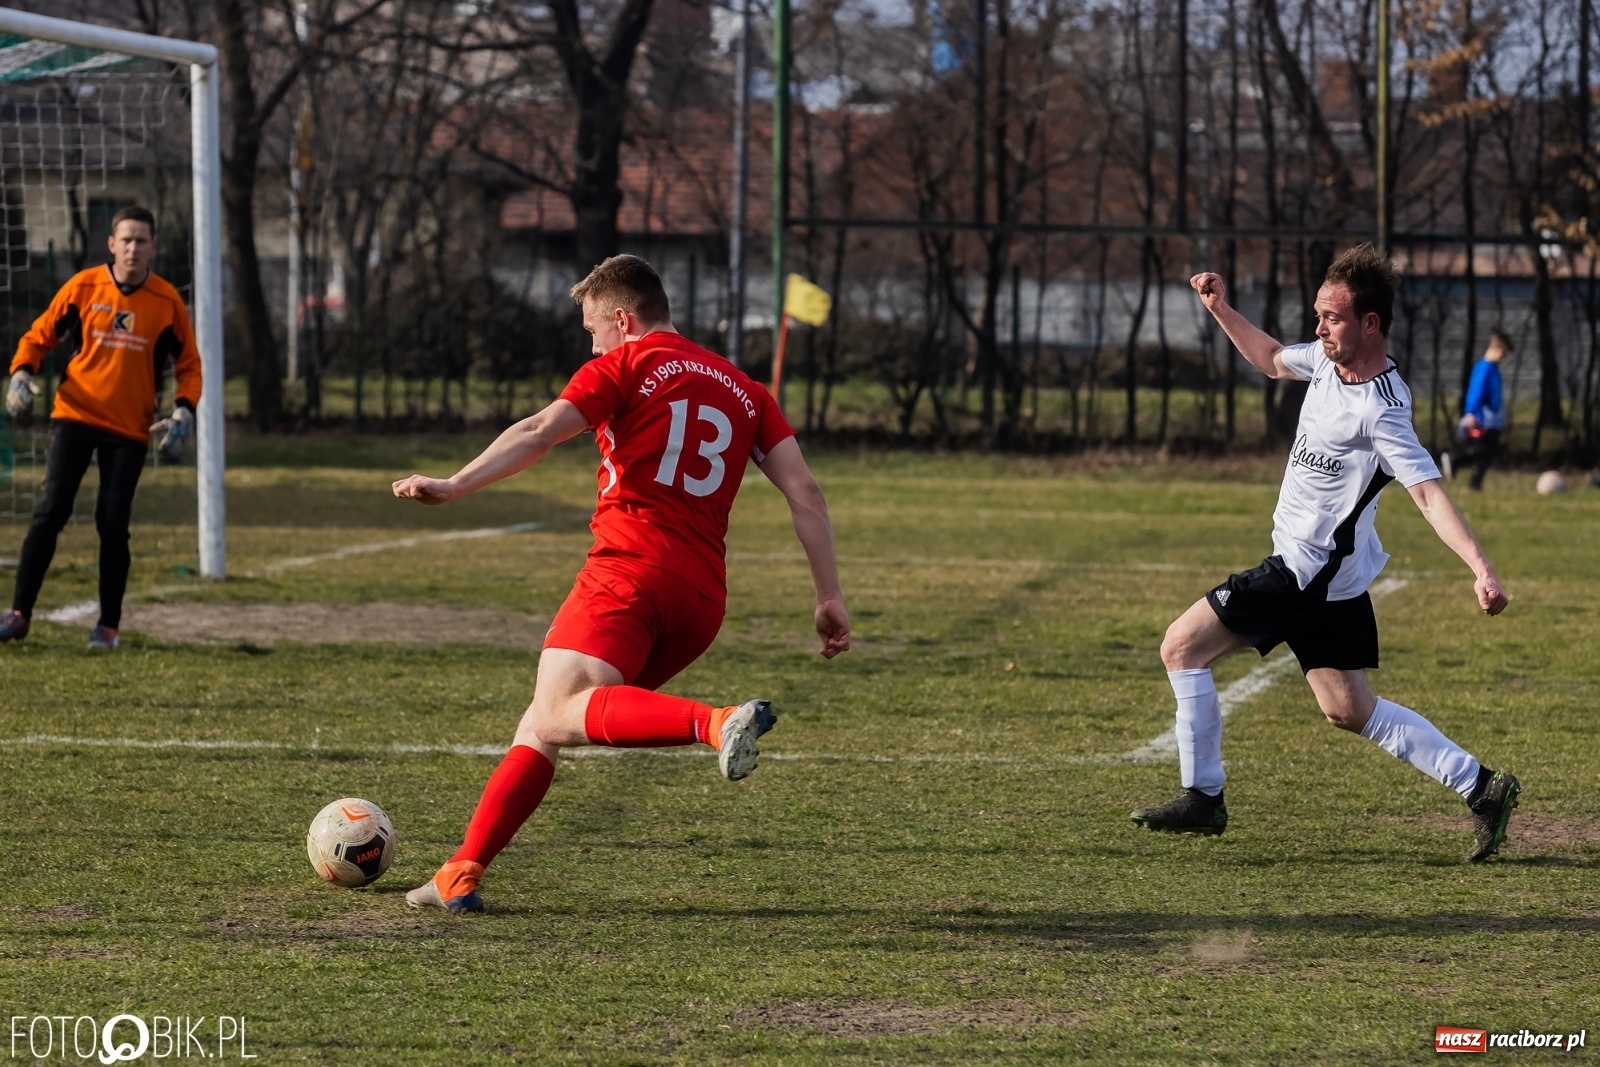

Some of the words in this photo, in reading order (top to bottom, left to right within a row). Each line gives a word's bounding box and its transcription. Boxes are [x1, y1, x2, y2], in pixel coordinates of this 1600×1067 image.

[639, 377, 657, 397] KS
[653, 360, 683, 382] 1905
[682, 359, 756, 418] KRZANOWICE
[654, 399, 733, 497] 13
[356, 847, 381, 864] JAKO
